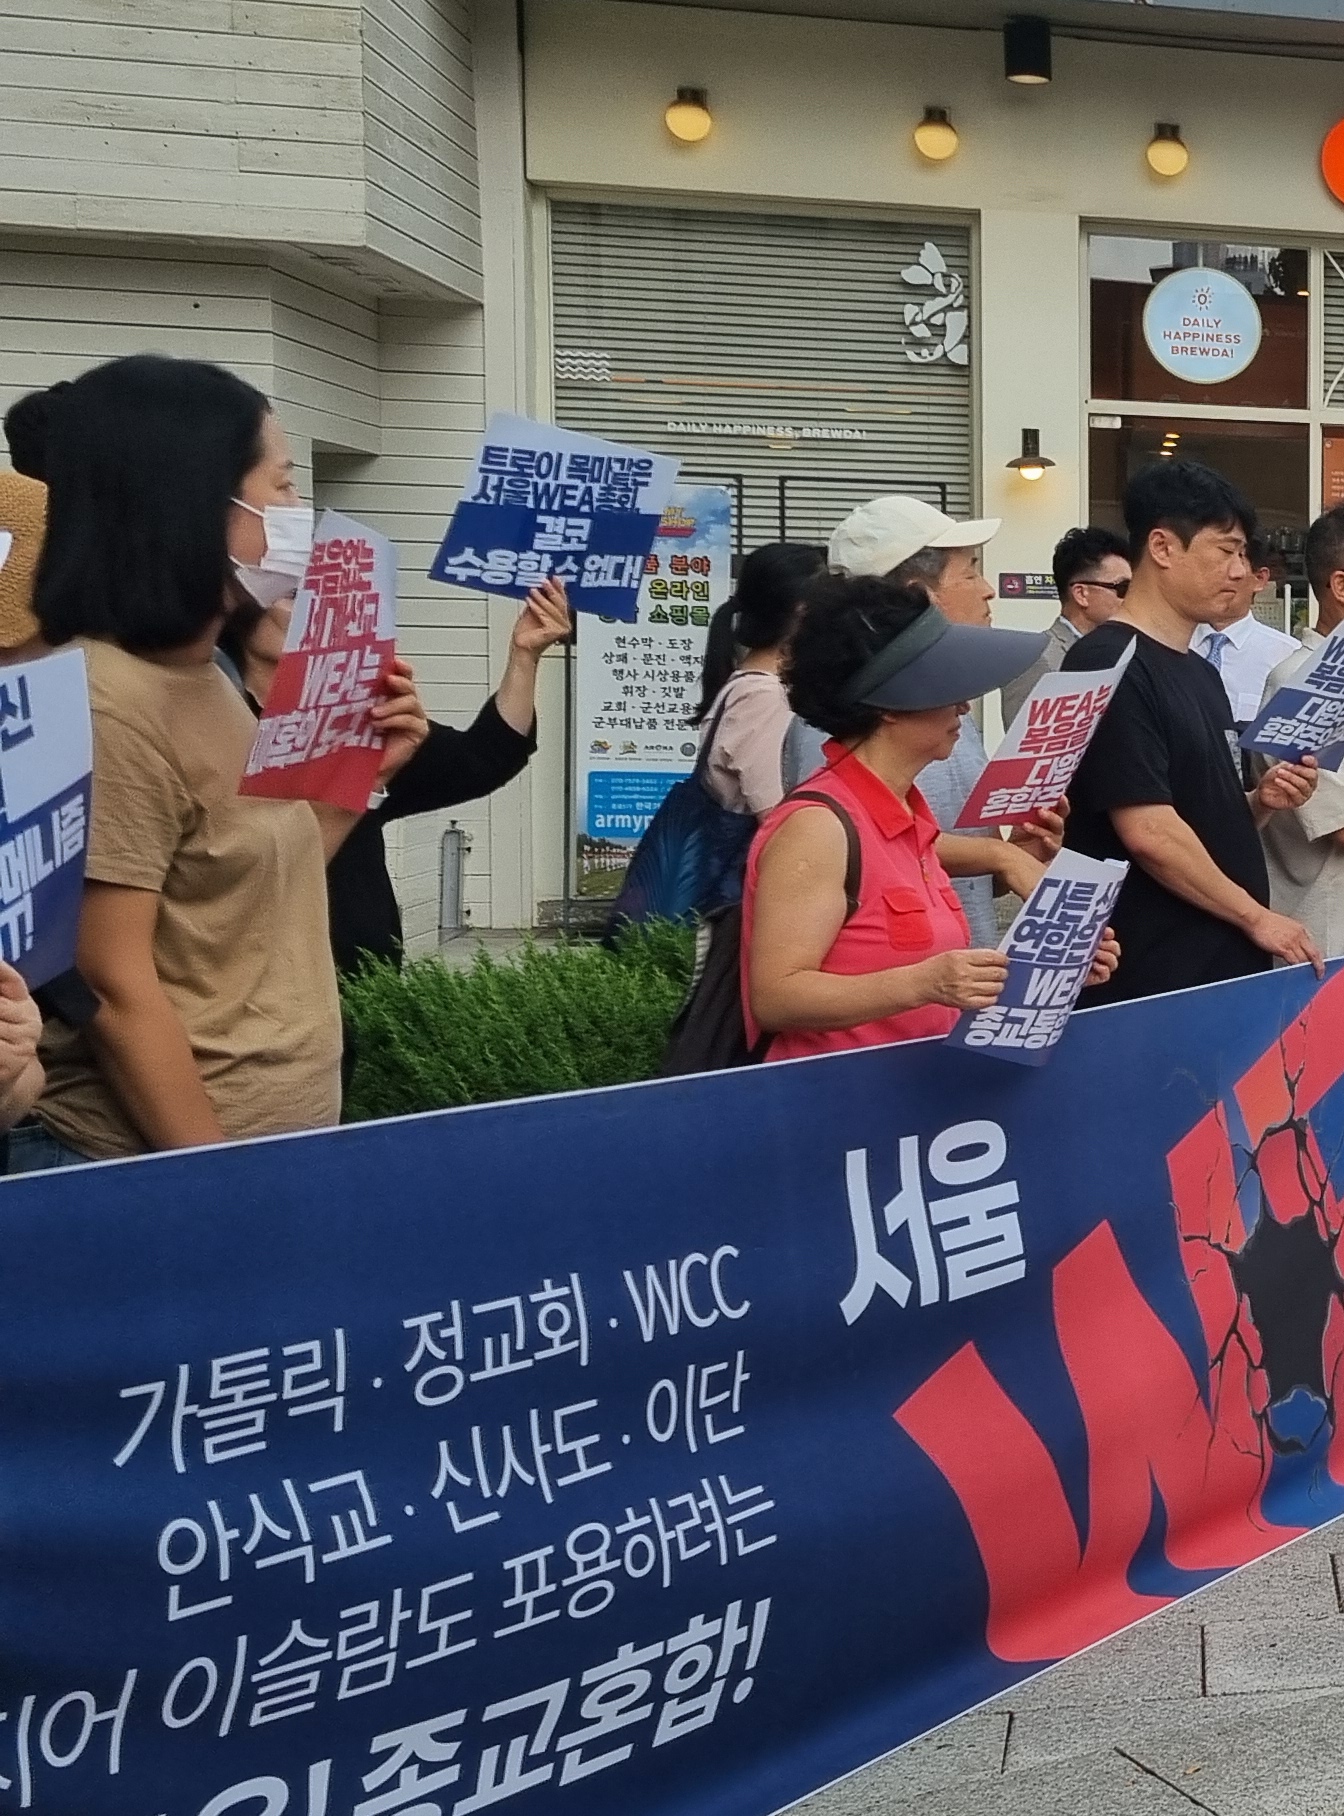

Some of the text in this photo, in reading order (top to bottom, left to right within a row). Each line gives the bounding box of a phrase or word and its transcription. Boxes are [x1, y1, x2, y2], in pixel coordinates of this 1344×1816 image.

[1163, 331, 1241, 345] HAPPINESS
[1182, 317, 1222, 329] DAILY
[1171, 345, 1234, 359] BREWDA!
[667, 421, 707, 434] DAILY
[802, 428, 868, 441] BREWDA!
[478, 446, 654, 488] 트로이 목마같은
[532, 514, 593, 552] 결코
[444, 546, 645, 590] 수용할 수 없다!
[670, 554, 712, 577] 분야
[648, 578, 710, 602] 온라인
[648, 604, 711, 627] 쇼핑몰
[615, 636, 694, 651] 현수막 도장
[298, 646, 381, 710] WEA는
[612, 668, 696, 683] 행사 시상용품
[601, 701, 627, 713] 교회
[621, 685, 687, 699] 휘장 깃발
[1028, 684, 1113, 727] WEA는
[592, 716, 658, 730] 군부대납품
[1018, 714, 1094, 756] 복음을
[595, 813, 654, 833] armyp
[1025, 877, 1100, 920] 다른
[1006, 909, 1097, 965] 연합은
[840, 1119, 1027, 1325] 서울
[112, 1244, 752, 1474] 가톨릭 정교회 WCC
[157, 1349, 752, 1622] 안식교 신사도 이단
[161, 1571, 478, 1738] 이슬람도
[493, 1473, 778, 1638] 포용하려는
[352, 1597, 773, 1816] 종교혼합!
